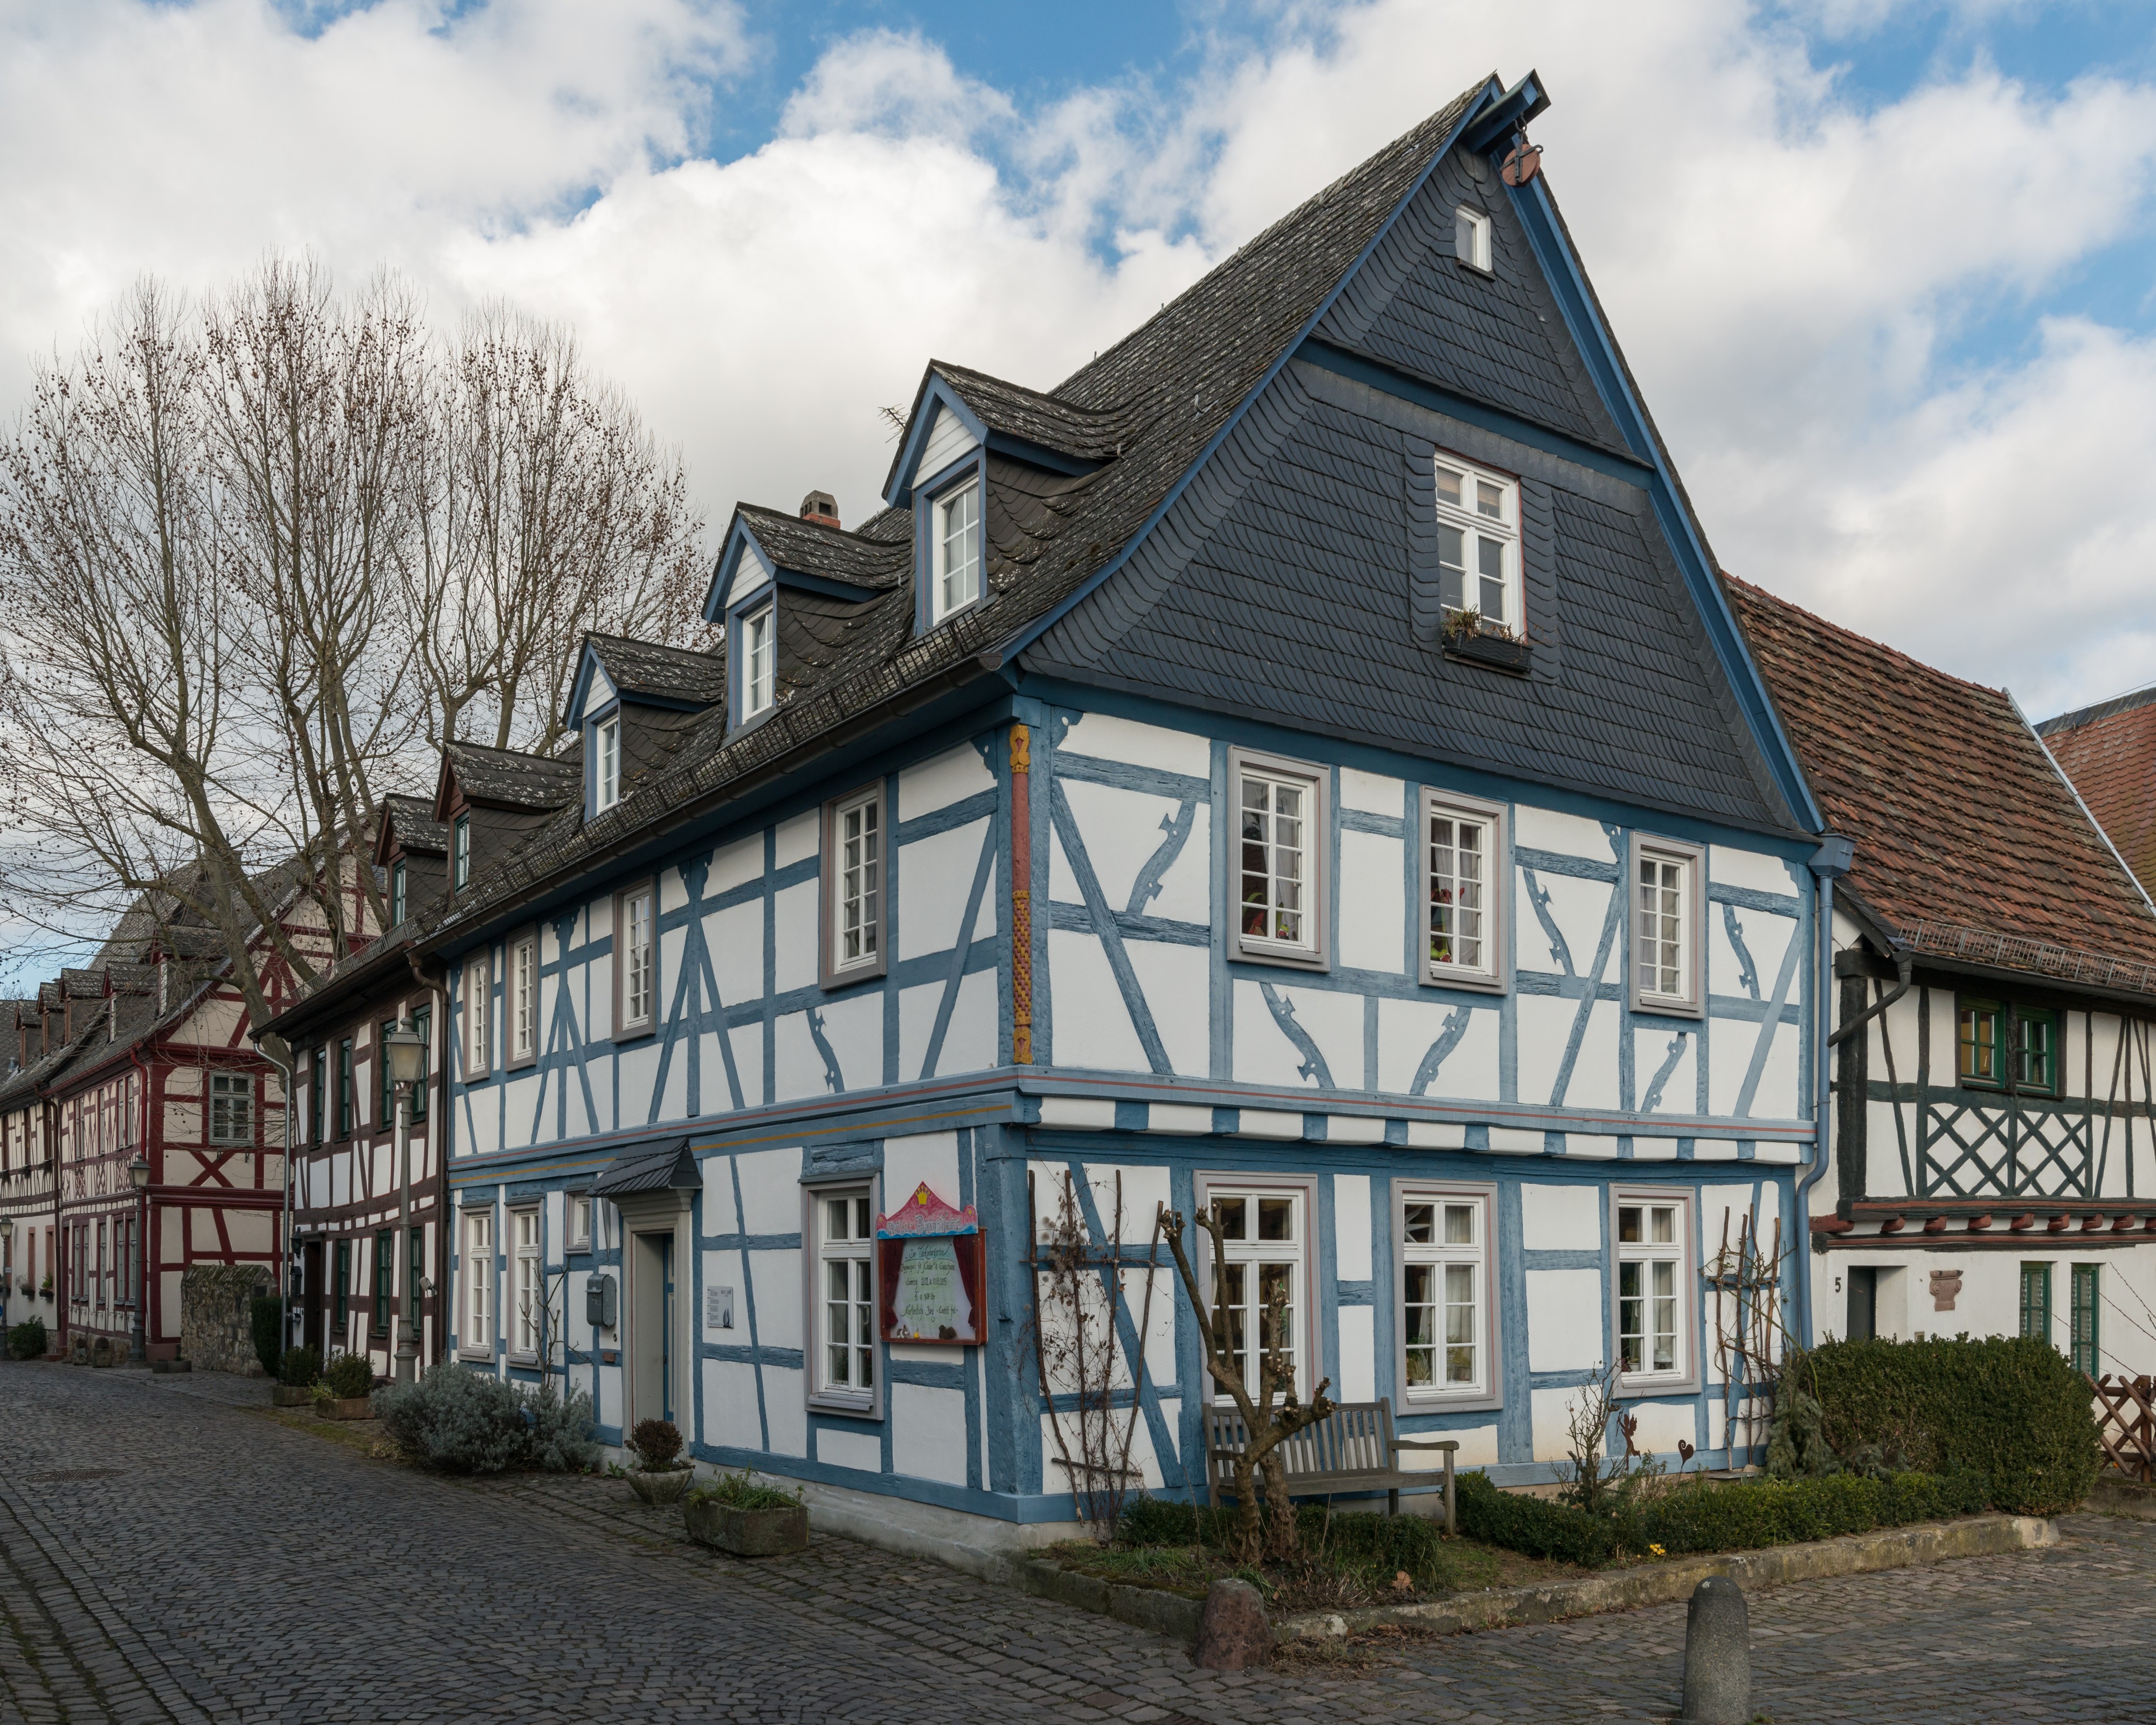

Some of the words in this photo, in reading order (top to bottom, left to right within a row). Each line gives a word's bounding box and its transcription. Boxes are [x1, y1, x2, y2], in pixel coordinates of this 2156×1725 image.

[921, 1261, 933, 1273] Kinder
[1835, 1277, 1841, 1293] 5
[925, 1306, 936, 1322] Burg
